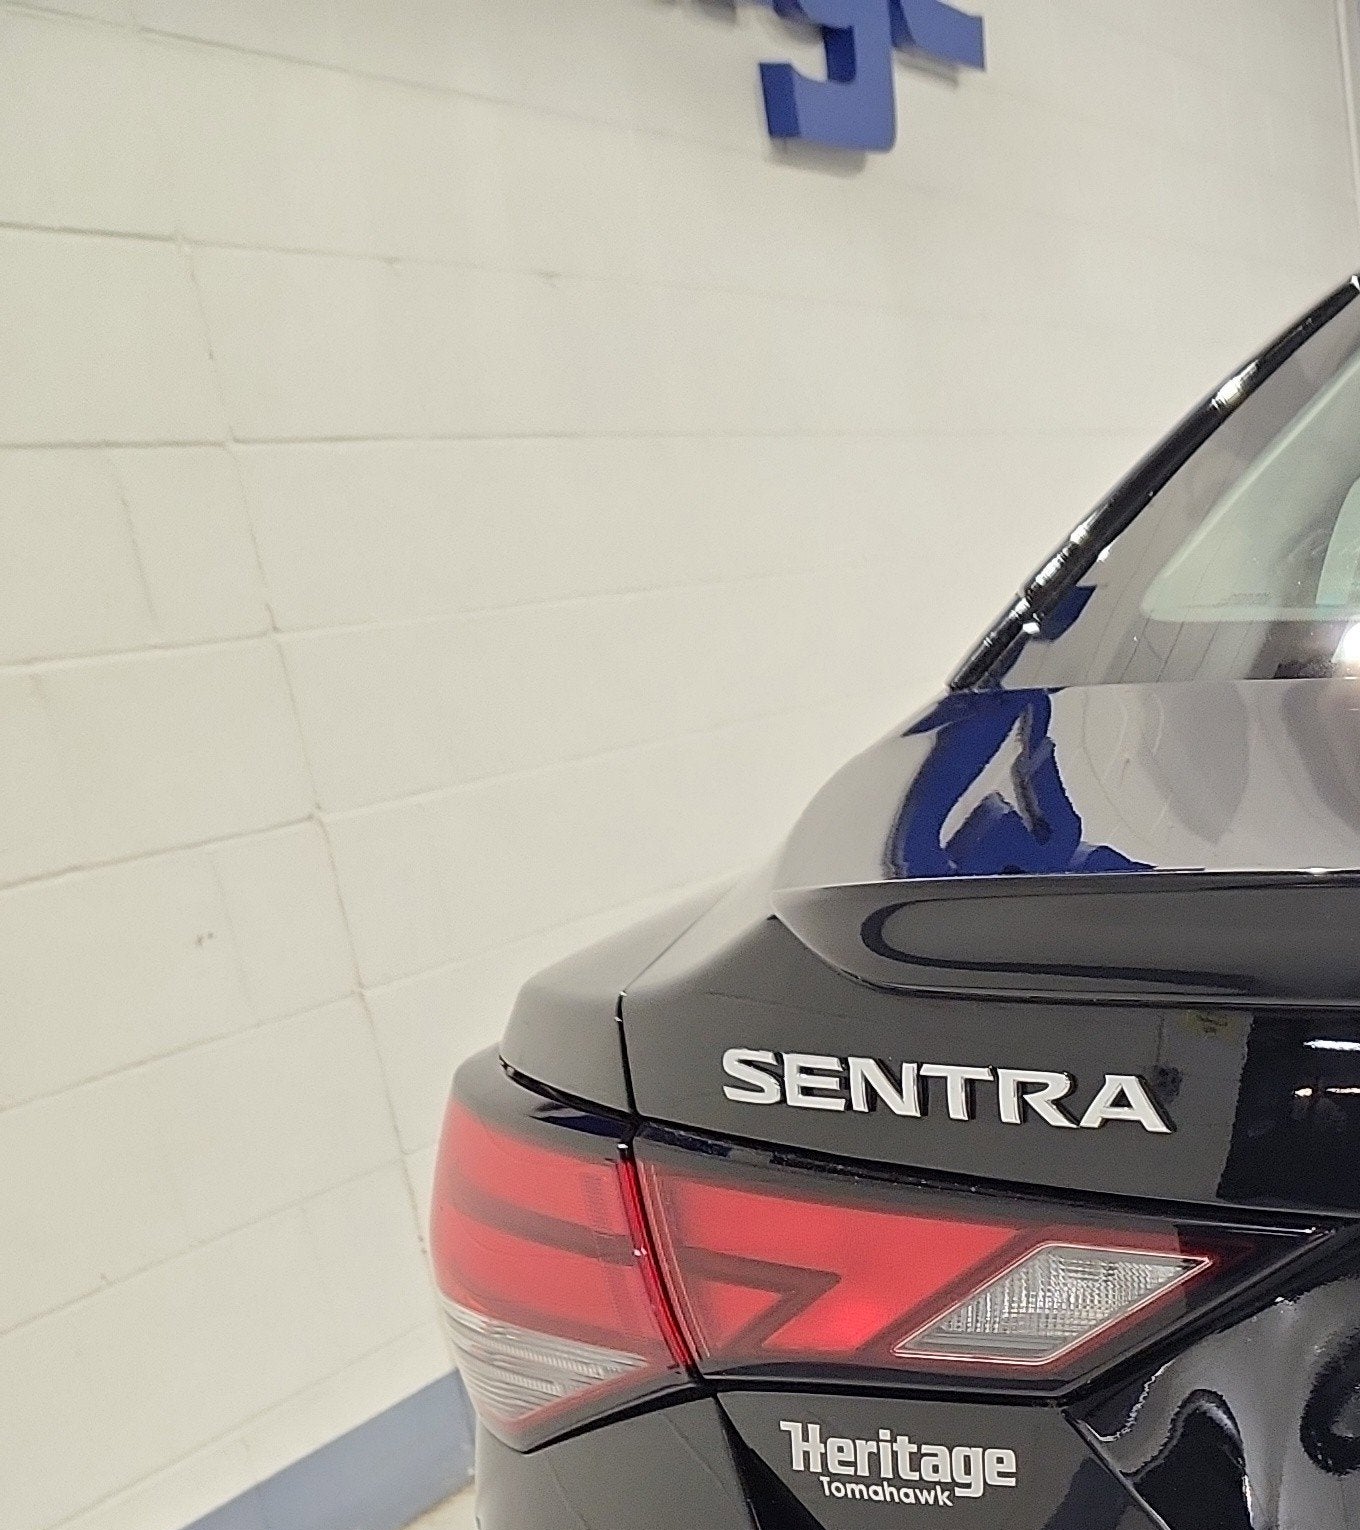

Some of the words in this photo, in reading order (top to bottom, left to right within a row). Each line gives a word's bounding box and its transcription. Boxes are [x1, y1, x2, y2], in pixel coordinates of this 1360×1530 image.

[721, 1046, 1174, 1134] SENTRA
[779, 1419, 1017, 1498] Heritage
[819, 1475, 954, 1507] Tomahawk
